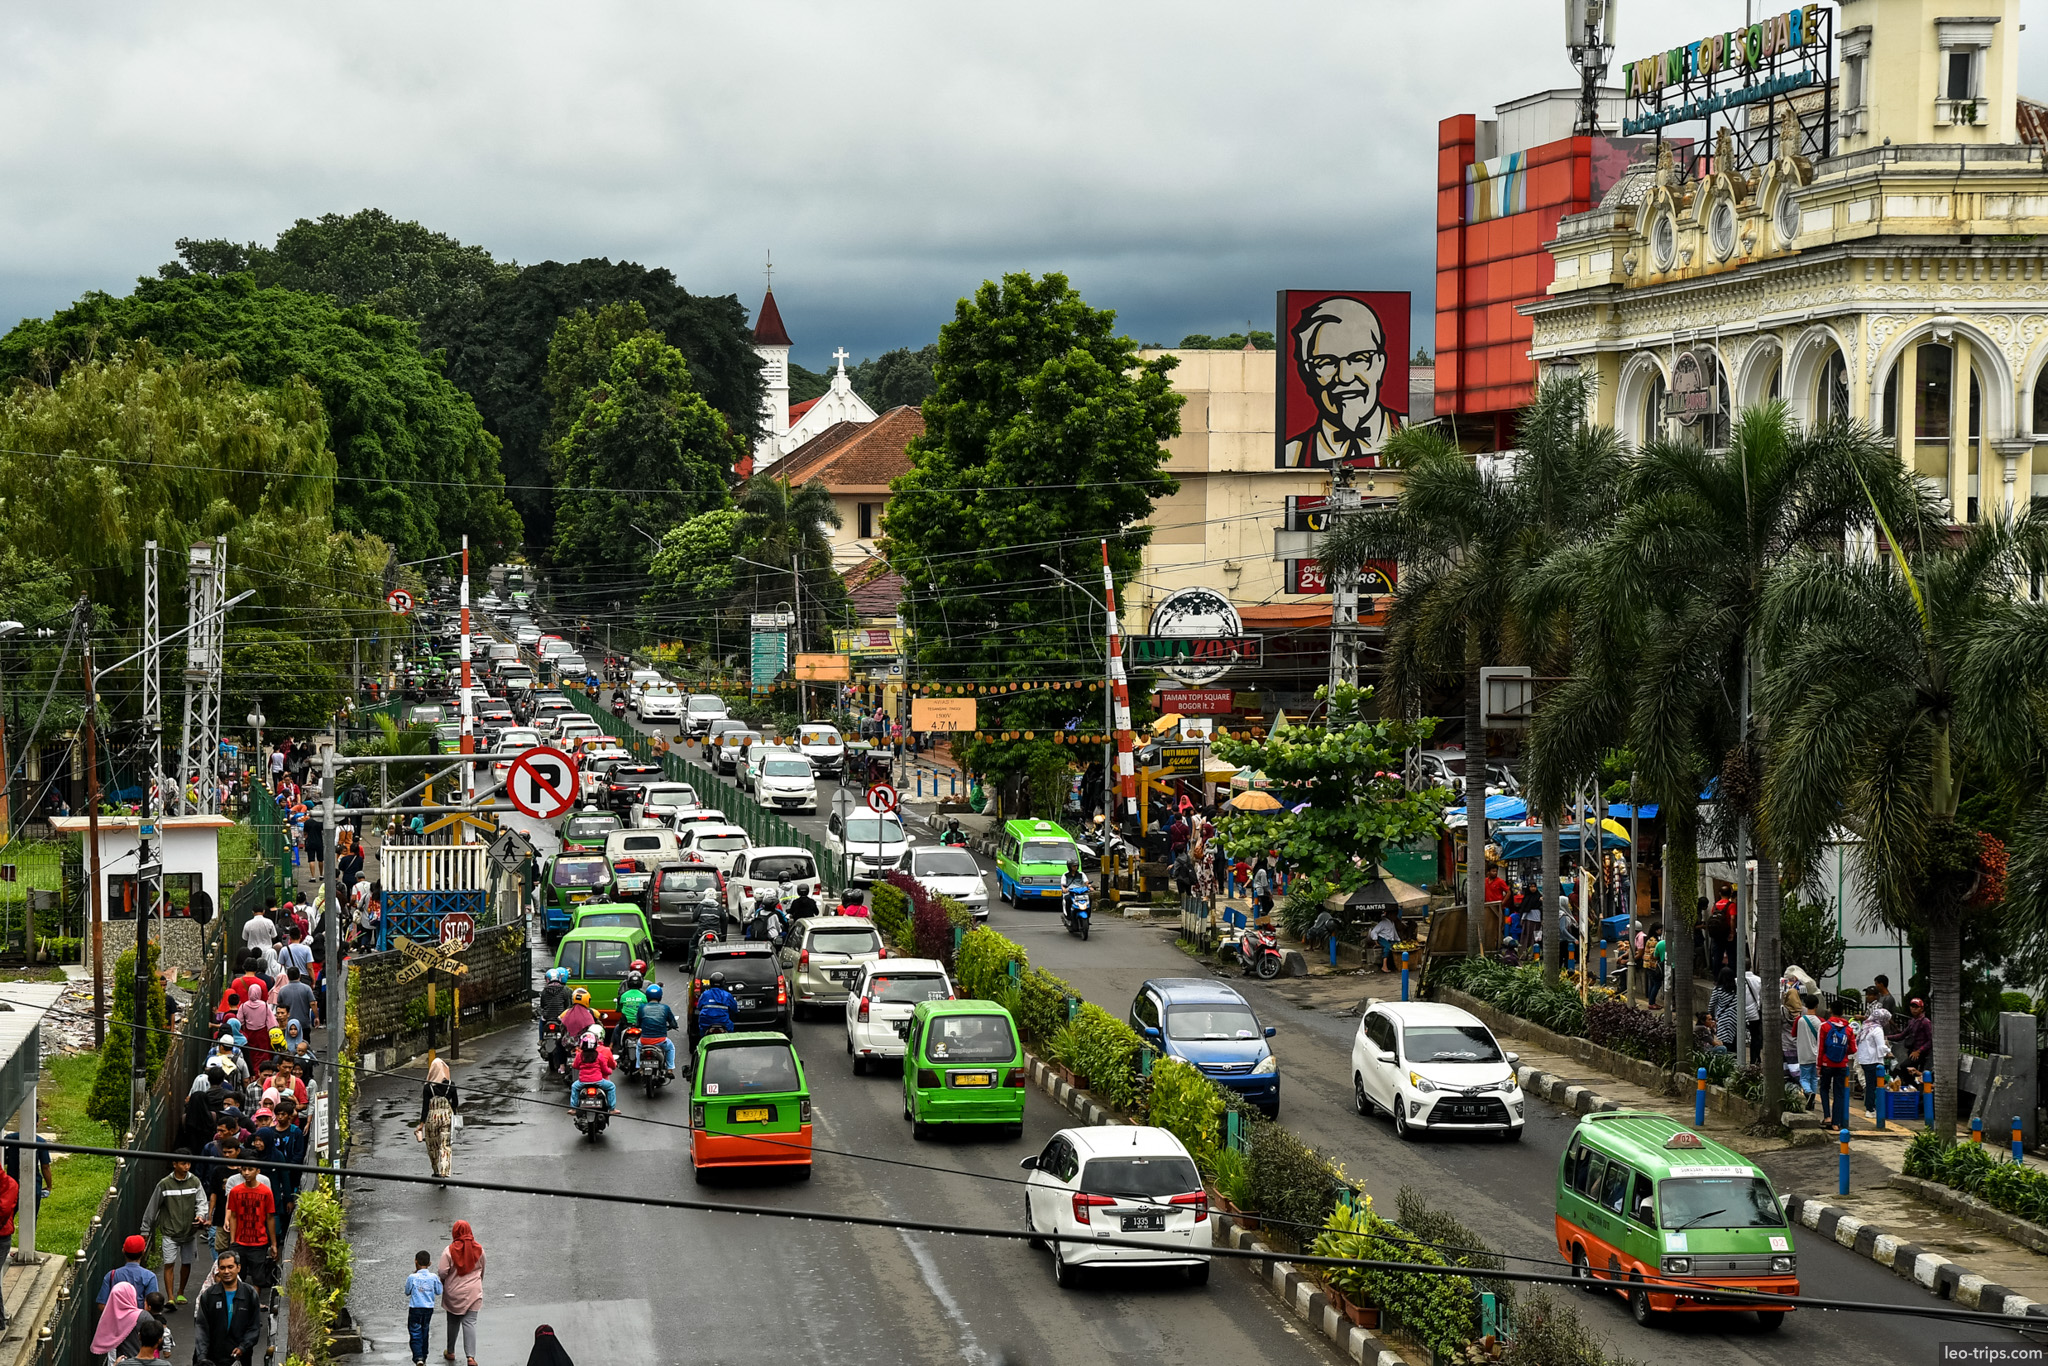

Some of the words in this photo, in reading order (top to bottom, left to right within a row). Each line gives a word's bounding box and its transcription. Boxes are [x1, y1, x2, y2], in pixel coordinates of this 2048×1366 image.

[1623, 47, 1683, 100] TAMAN
[1688, 32, 1732, 79] TOPI
[1734, 4, 1818, 70] SQUARE
[1300, 573, 1327, 588] 24
[1136, 639, 1257, 662] AMAZONE
[1204, 693, 1230, 701] SQUARE
[1178, 702, 1202, 710] BOGOR
[931, 721, 945, 729] 4.7
[948, 721, 957, 730] M
[445, 921, 469, 941] STOP
[404, 942, 438, 967] KERETA
[399, 964, 421, 983] SATU
[435, 939, 461, 957] SEPUR
[708, 1085, 717, 1093] 02
[1122, 1218, 1127, 1226] F
[1133, 1217, 1149, 1225] 1335
[1772, 1238, 1786, 1247] 02
